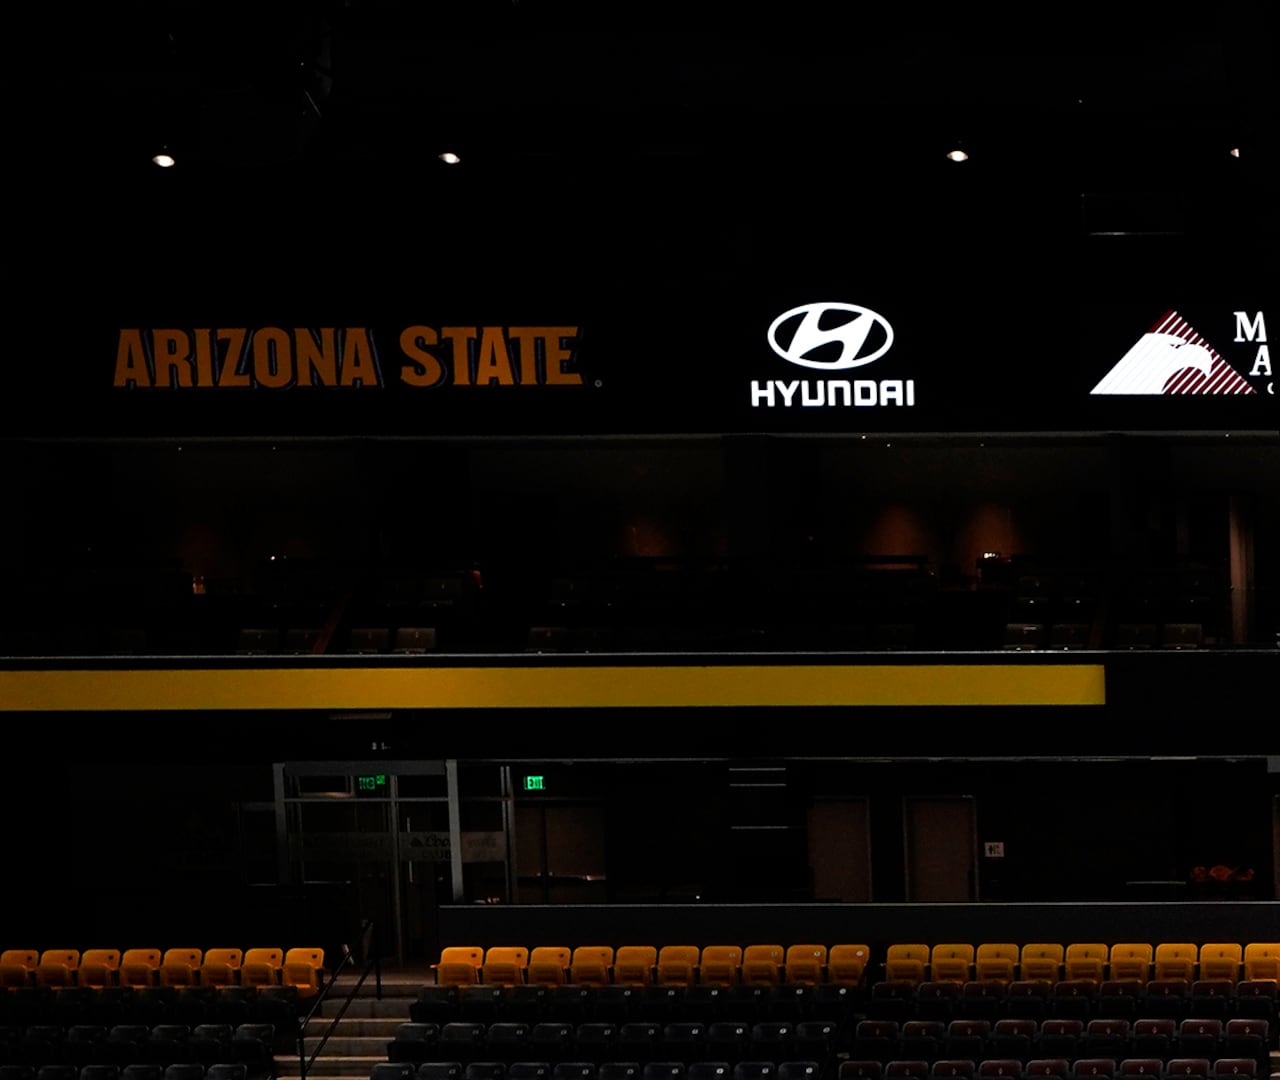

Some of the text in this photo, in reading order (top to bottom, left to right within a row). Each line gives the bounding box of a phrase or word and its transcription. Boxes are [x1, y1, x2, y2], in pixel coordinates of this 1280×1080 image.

[114, 325, 583, 389] ARIZONA STATE
[751, 380, 914, 406] HYUNDAI
